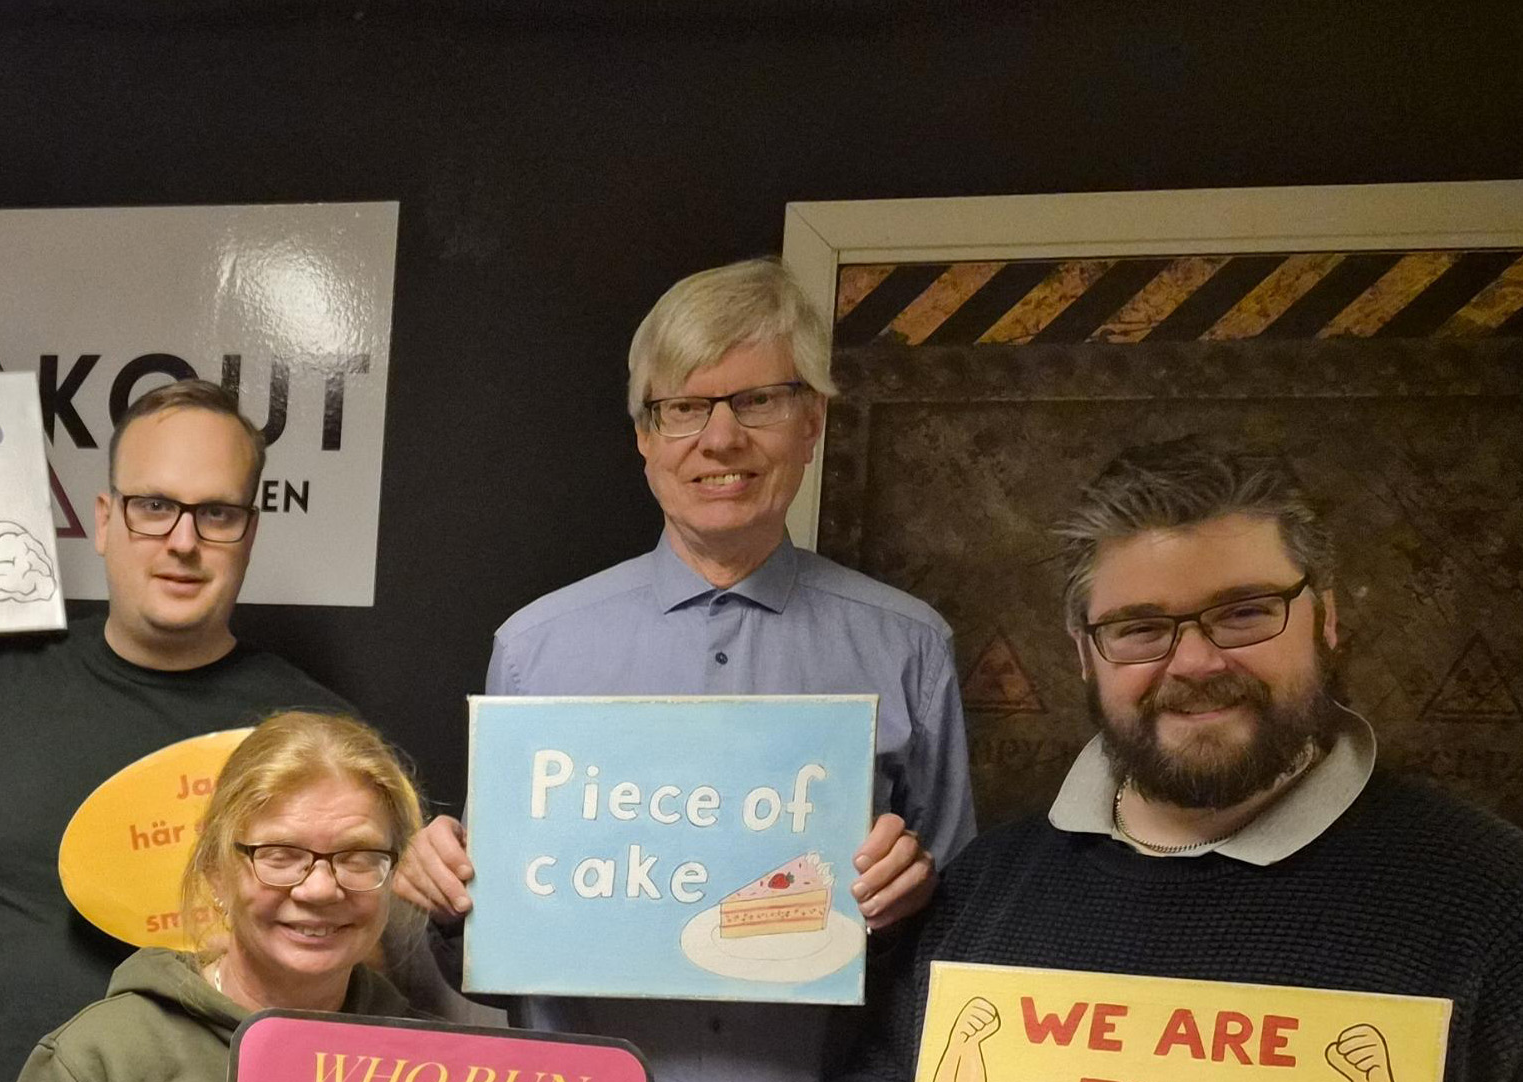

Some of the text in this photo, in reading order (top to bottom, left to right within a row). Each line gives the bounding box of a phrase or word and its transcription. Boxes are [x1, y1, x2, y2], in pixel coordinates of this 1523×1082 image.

[176, 774, 215, 800] Ja
[530, 749, 827, 833] Piece of
[130, 820, 185, 851] här
[524, 844, 709, 904] cake
[1020, 996, 1299, 1068] WE ARE
